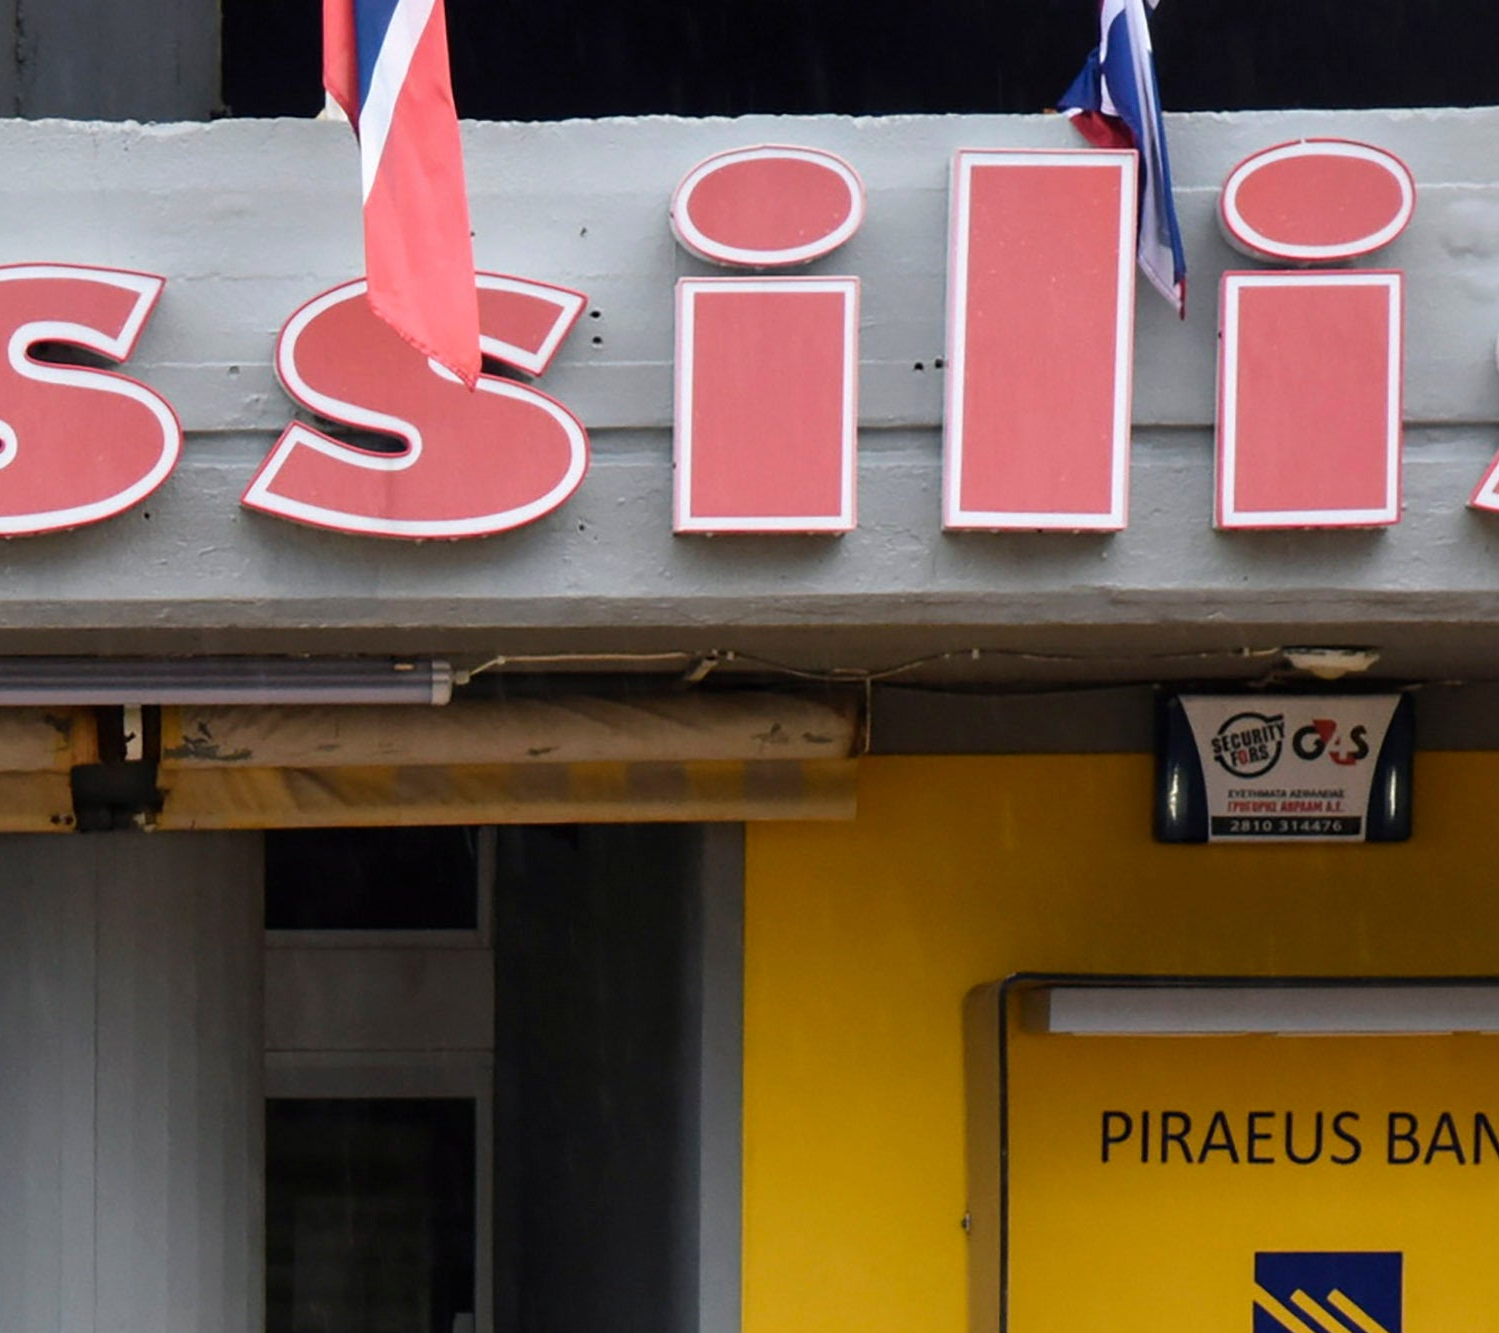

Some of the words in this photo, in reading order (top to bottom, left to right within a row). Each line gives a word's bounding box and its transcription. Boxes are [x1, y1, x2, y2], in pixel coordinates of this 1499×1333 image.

[1211, 722, 1285, 755] SECURITY
[1292, 719, 1369, 766] G4S
[1231, 746, 1269, 767] FORS
[1229, 819, 1274, 833] 2810
[1278, 819, 1343, 833] 314476
[1099, 1109, 1362, 1166] PIRAEUS
